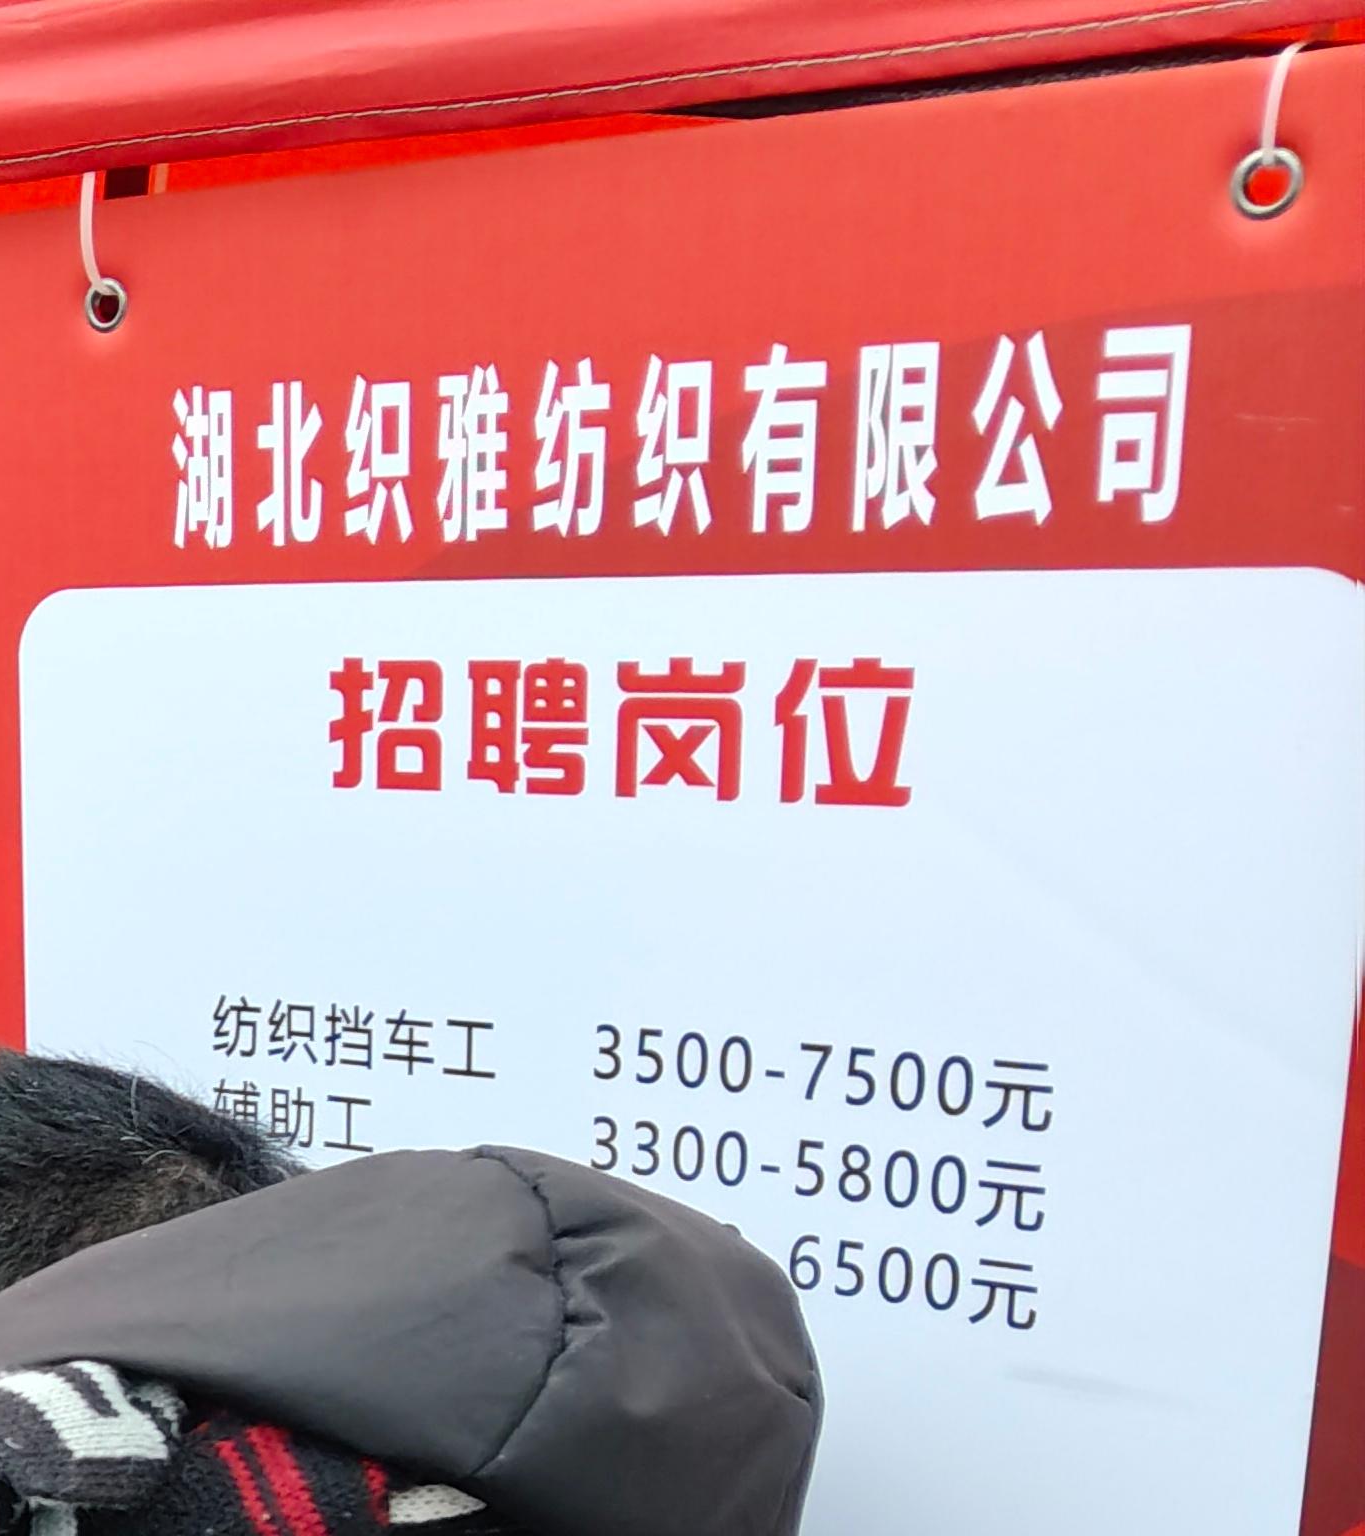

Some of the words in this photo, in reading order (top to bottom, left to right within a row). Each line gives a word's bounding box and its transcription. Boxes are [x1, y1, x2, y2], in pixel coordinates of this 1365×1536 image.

[172, 322, 1195, 549] 湖北织雅纺织有限公司
[328, 656, 915, 808] 招聘岗位
[212, 994, 496, 1079] 纺织挡车工
[592, 1023, 1054, 1132] 3500-7500元
[212, 1078, 373, 1152] 辅助工
[589, 1116, 1046, 1232] 3300-5800元
